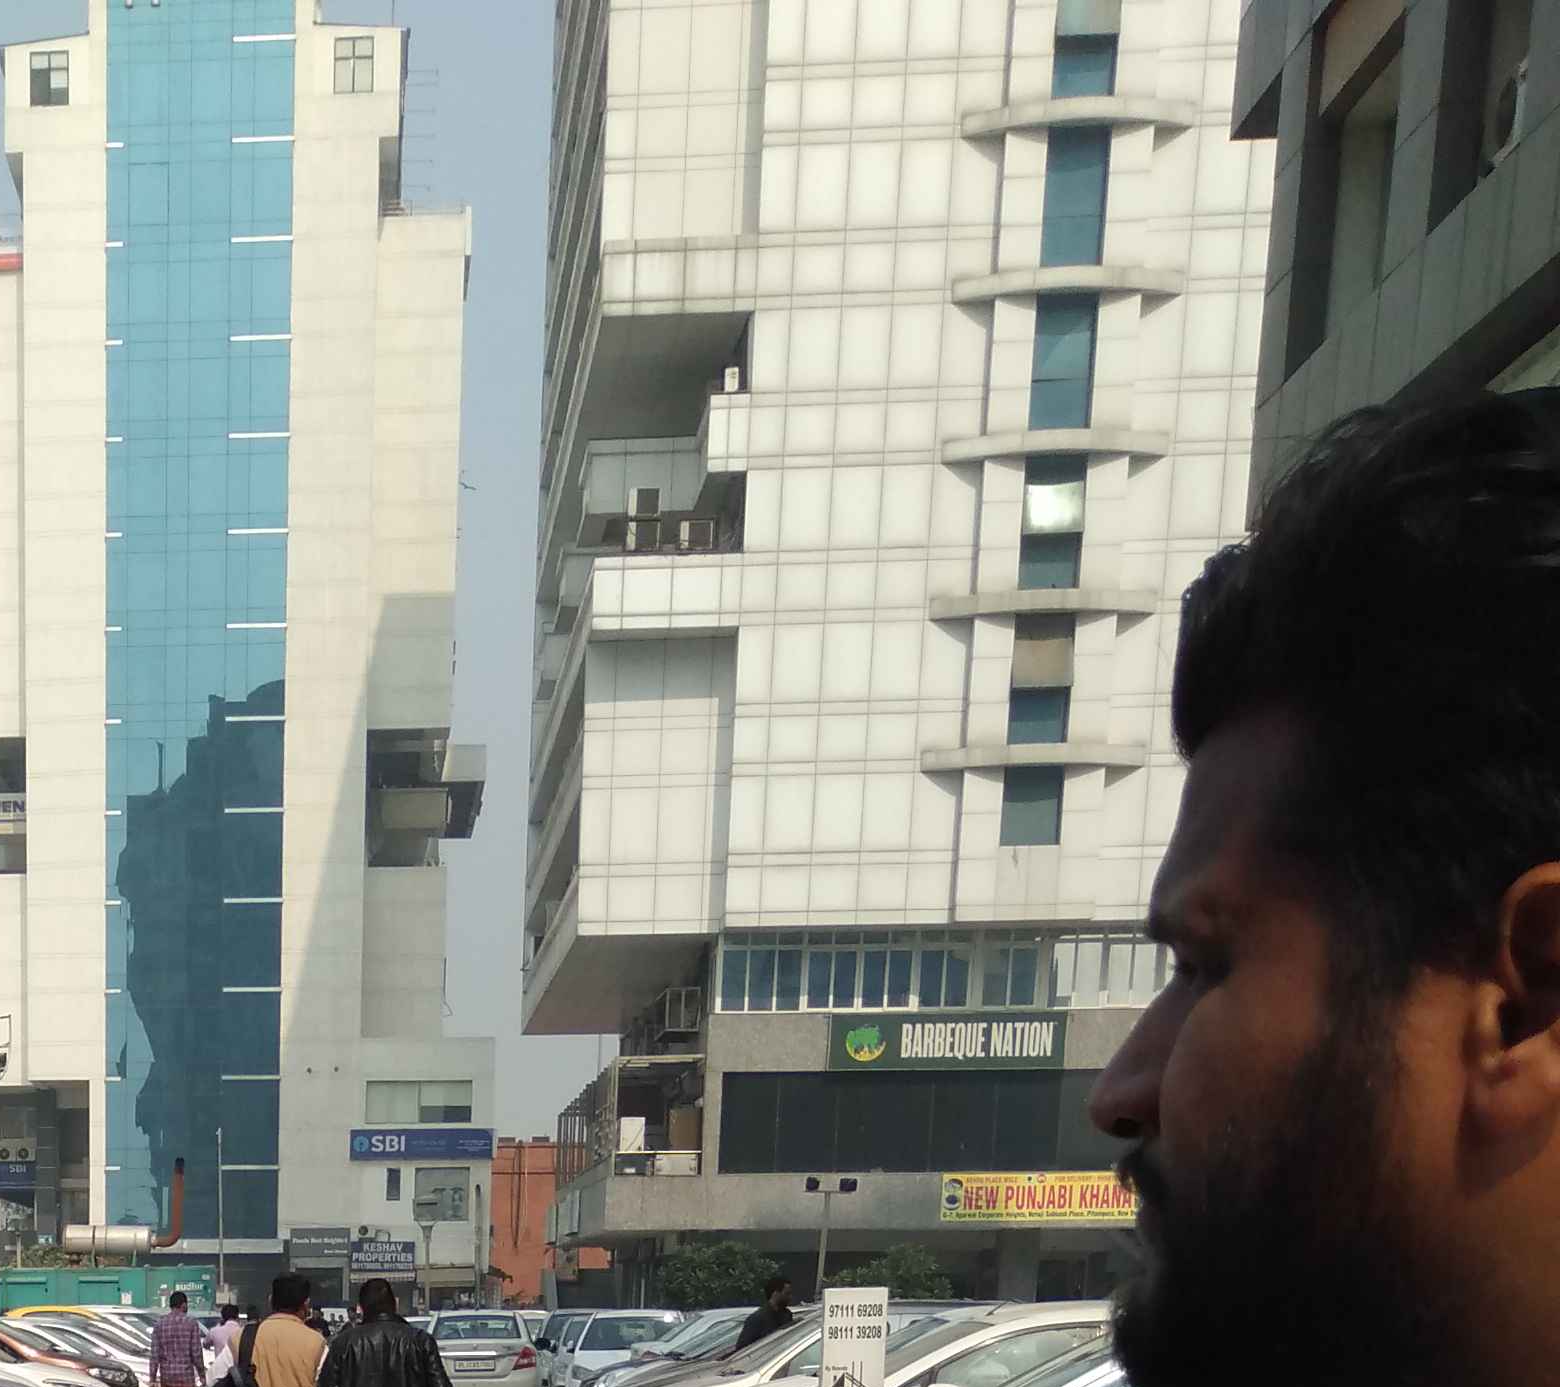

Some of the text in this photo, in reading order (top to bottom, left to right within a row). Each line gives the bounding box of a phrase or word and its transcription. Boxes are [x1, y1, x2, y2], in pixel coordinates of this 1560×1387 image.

[900, 1021, 1055, 1060] BARBEQUE NATION
[371, 1135, 406, 1152] SBI
[963, 1185, 1000, 1210] NEW
[1004, 1184, 1073, 1209] PUNJABI
[363, 1242, 403, 1252] KESHAV
[352, 1252, 413, 1262] PROPERTIES
[828, 1303, 883, 1318] 97111 69208
[828, 1325, 882, 1340] 98111 39208
